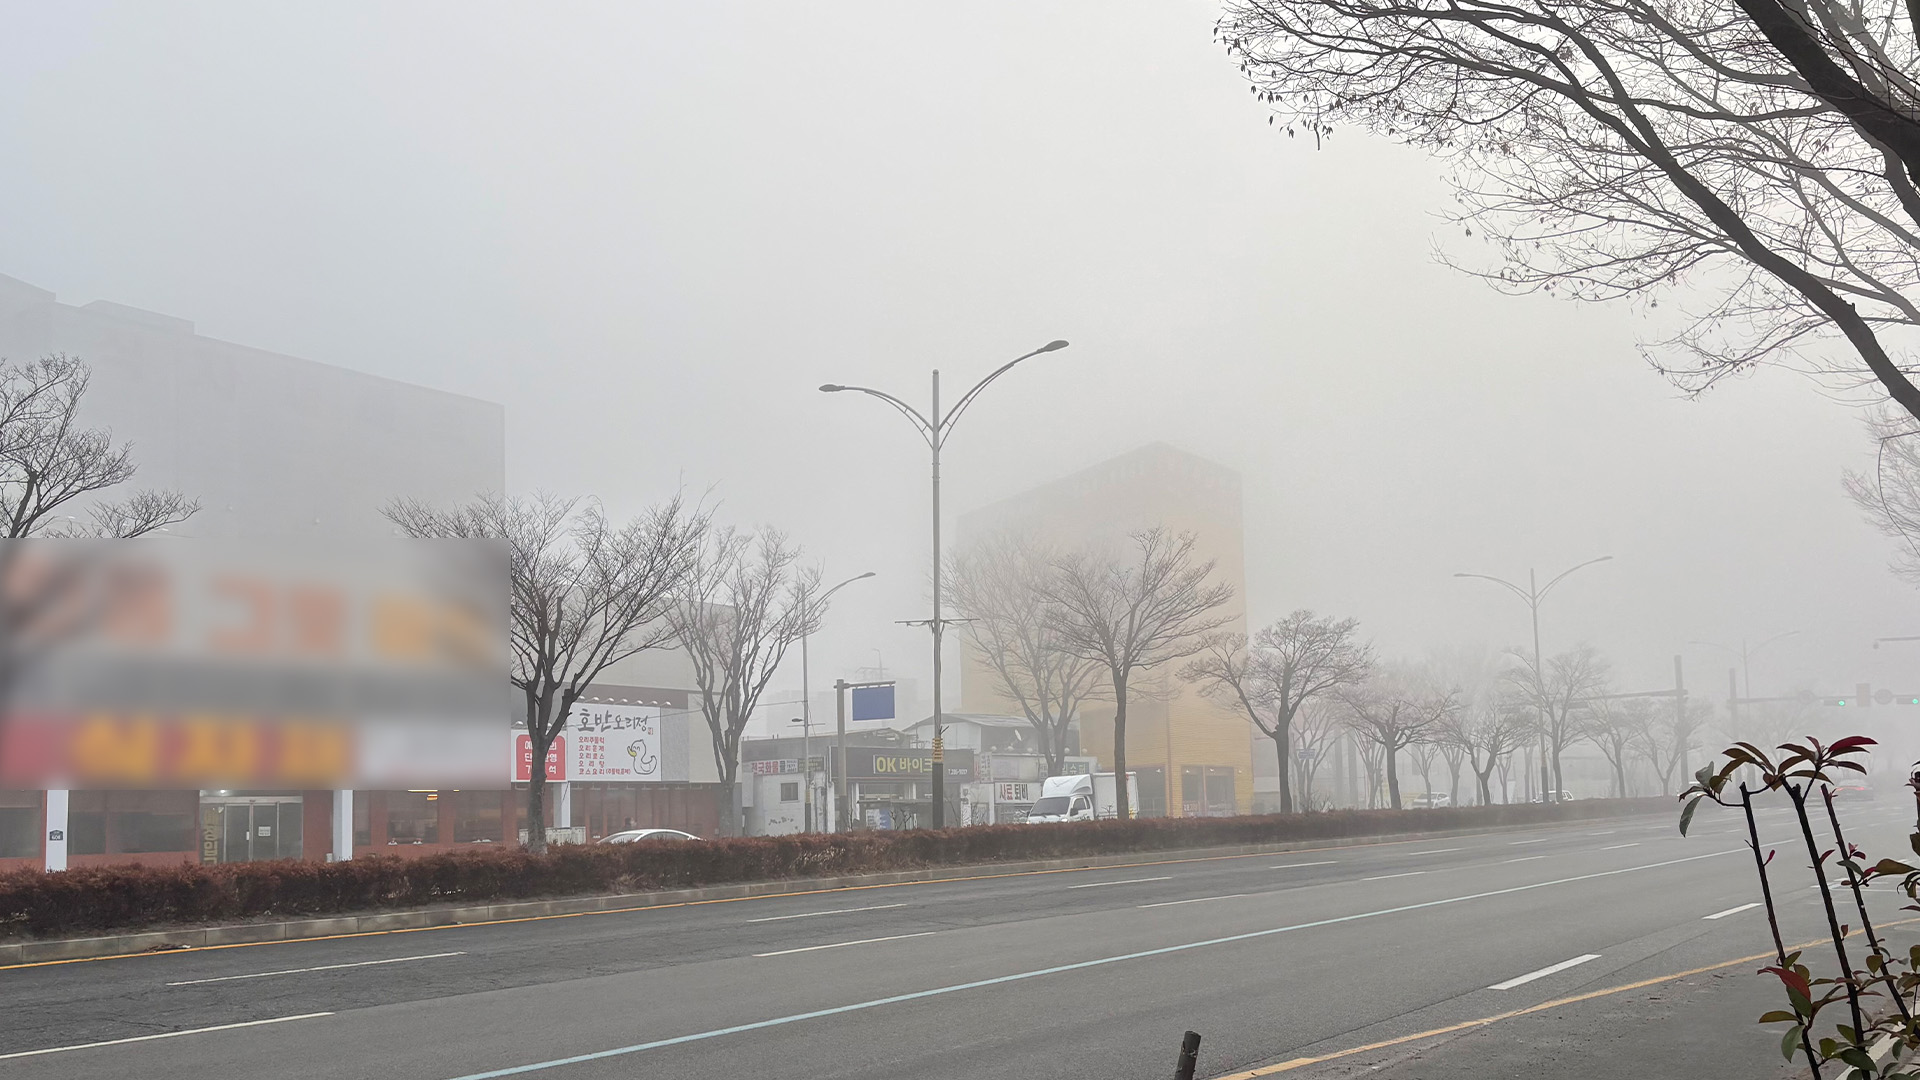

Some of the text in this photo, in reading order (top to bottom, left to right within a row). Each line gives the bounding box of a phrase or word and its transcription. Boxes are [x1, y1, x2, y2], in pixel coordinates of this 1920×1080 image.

[577, 708, 648, 732] 호반오리정
[876, 756, 897, 773] OK
[899, 757, 933, 773] 바이크
